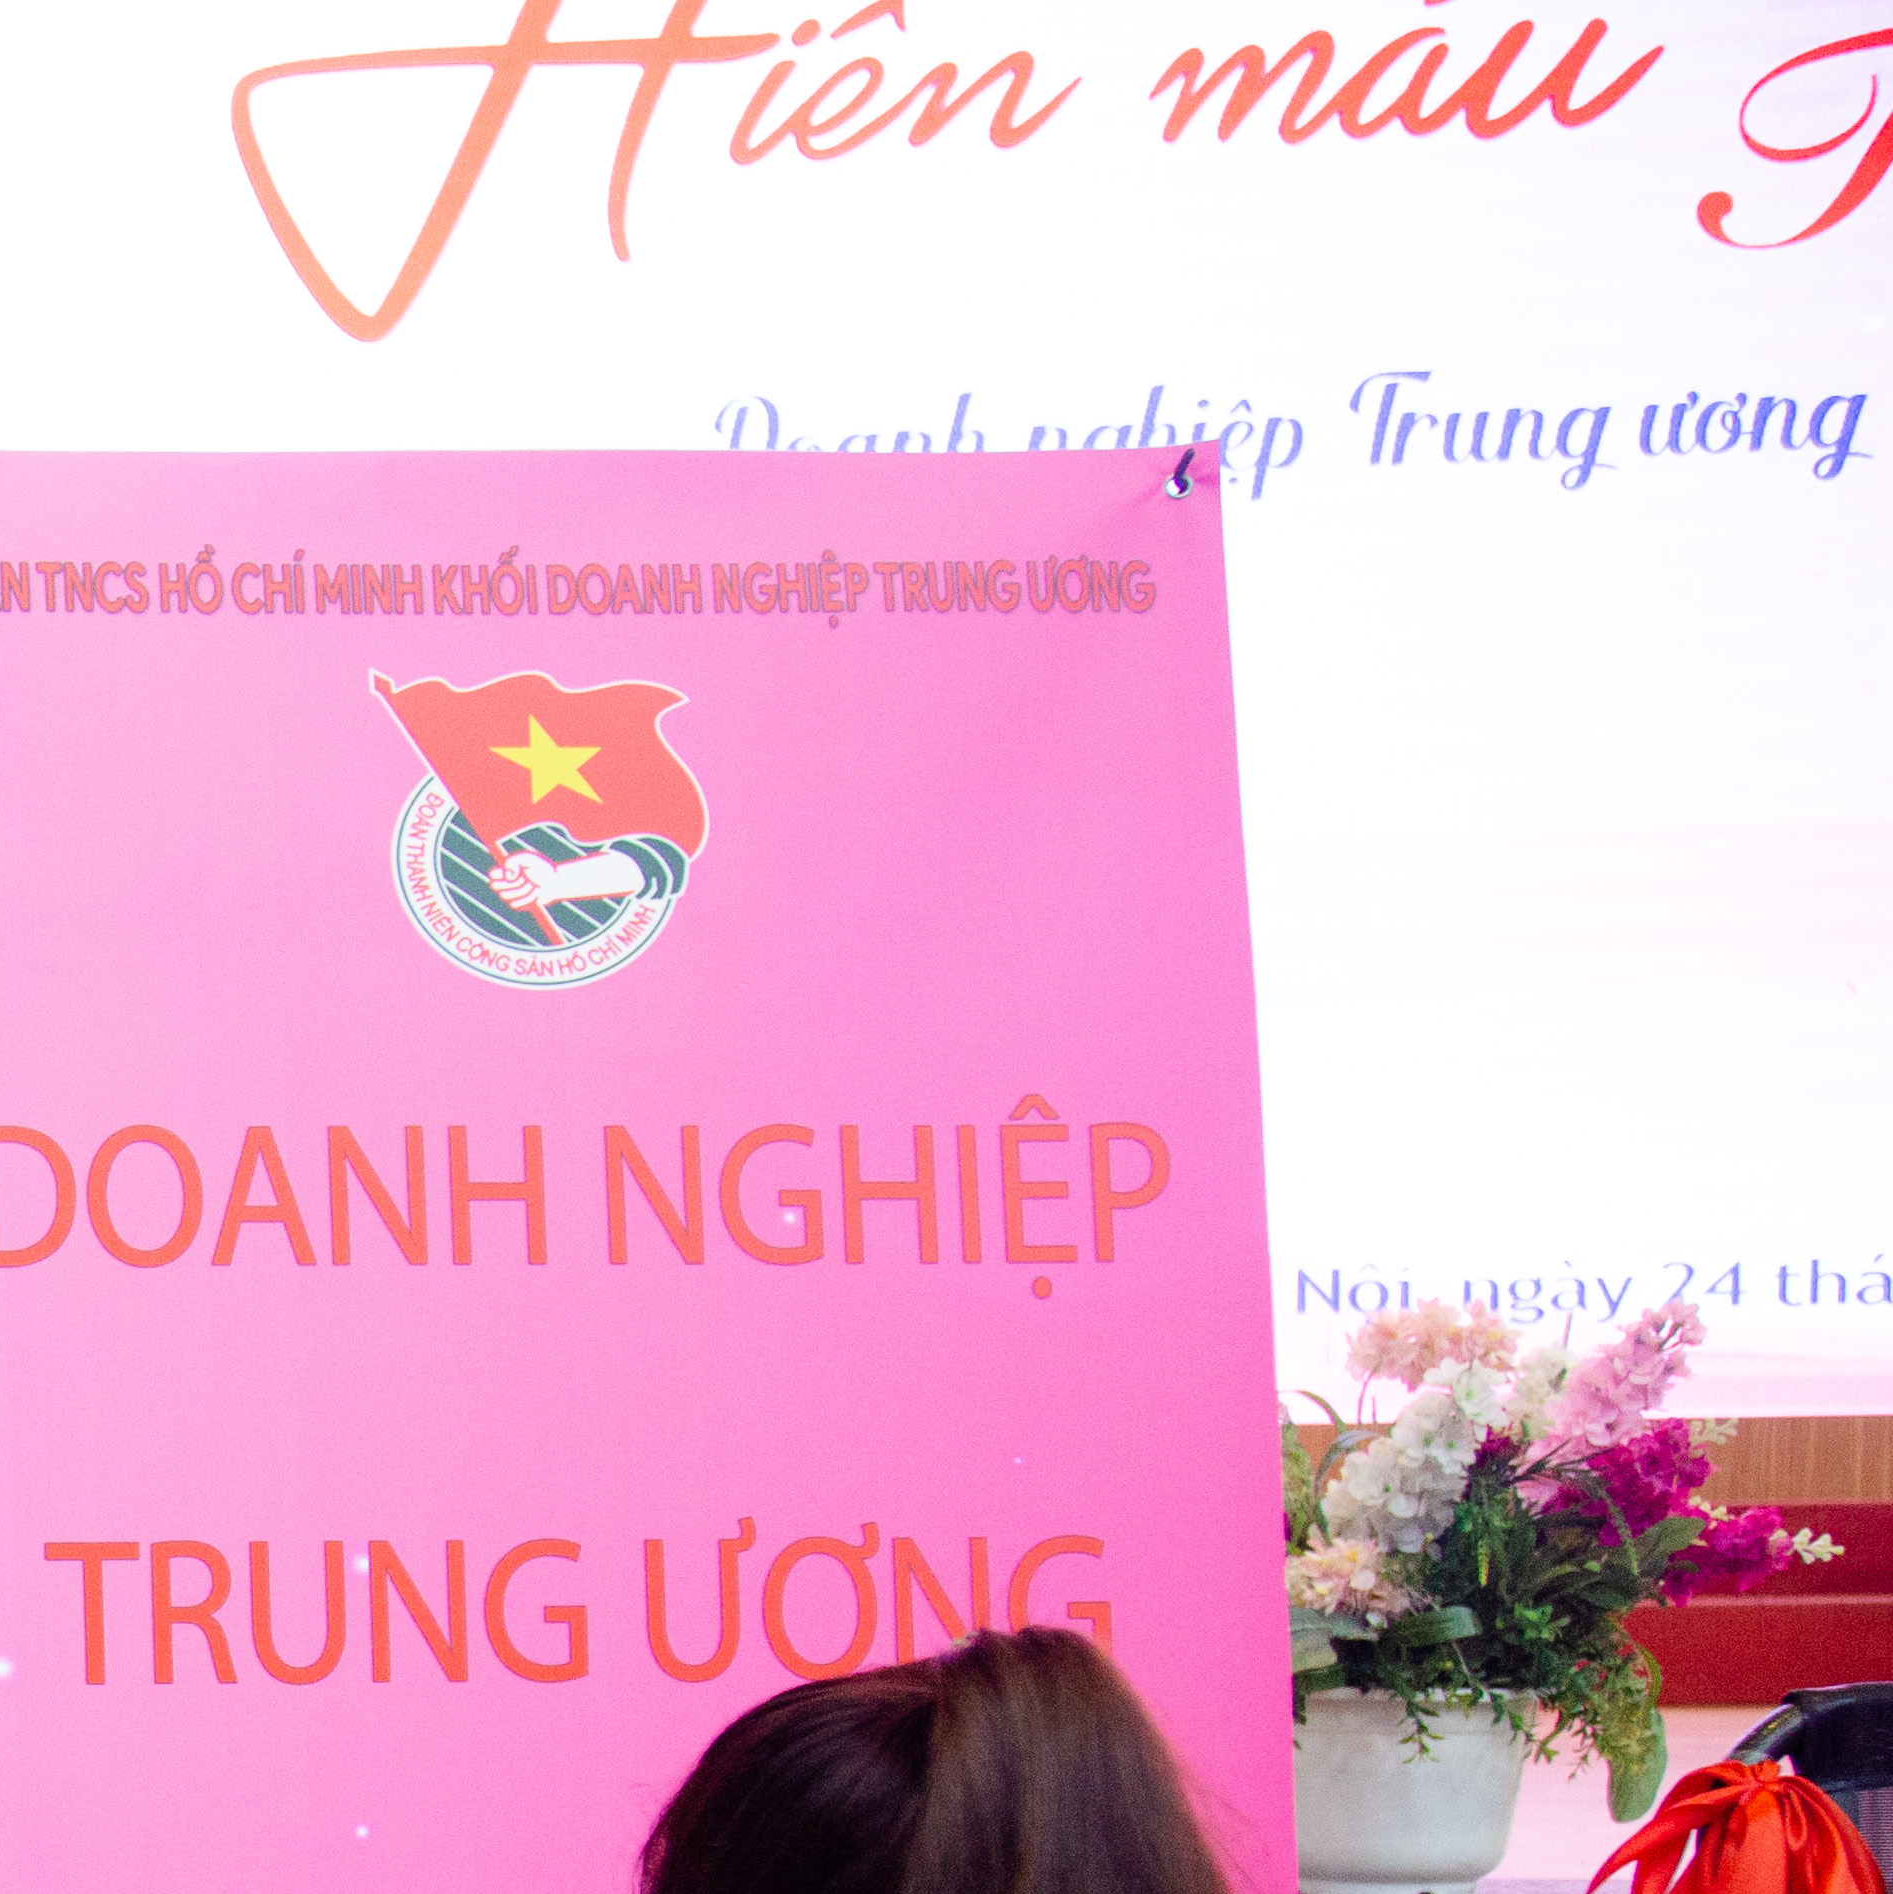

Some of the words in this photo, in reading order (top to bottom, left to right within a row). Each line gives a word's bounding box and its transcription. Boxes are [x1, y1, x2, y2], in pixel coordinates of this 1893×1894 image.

[1348, 370, 1617, 490] Trung
[1639, 390, 1873, 481] ương
[36, 561, 149, 613] TNCS
[159, 545, 224, 613] HỒ
[231, 549, 306, 614] CHÍ
[314, 563, 424, 614] MINH
[433, 545, 539, 614] KHỐI
[547, 562, 703, 614] DOANH
[713, 550, 869, 628] NGHIỆP
[875, 560, 1021, 612] TRUNG
[1029, 556, 1155, 612] ƯƠNG
[406, 843, 434, 902] THANH
[620, 904, 657, 948] MINH
[604, 1093, 1171, 1300] NGHIỆP
[1463, 1259, 1633, 1324] ngày
[1662, 1262, 1746, 1306] 24
[43, 1537, 590, 1685] TRUNG
[644, 1516, 1111, 1684] ƯƠNG
